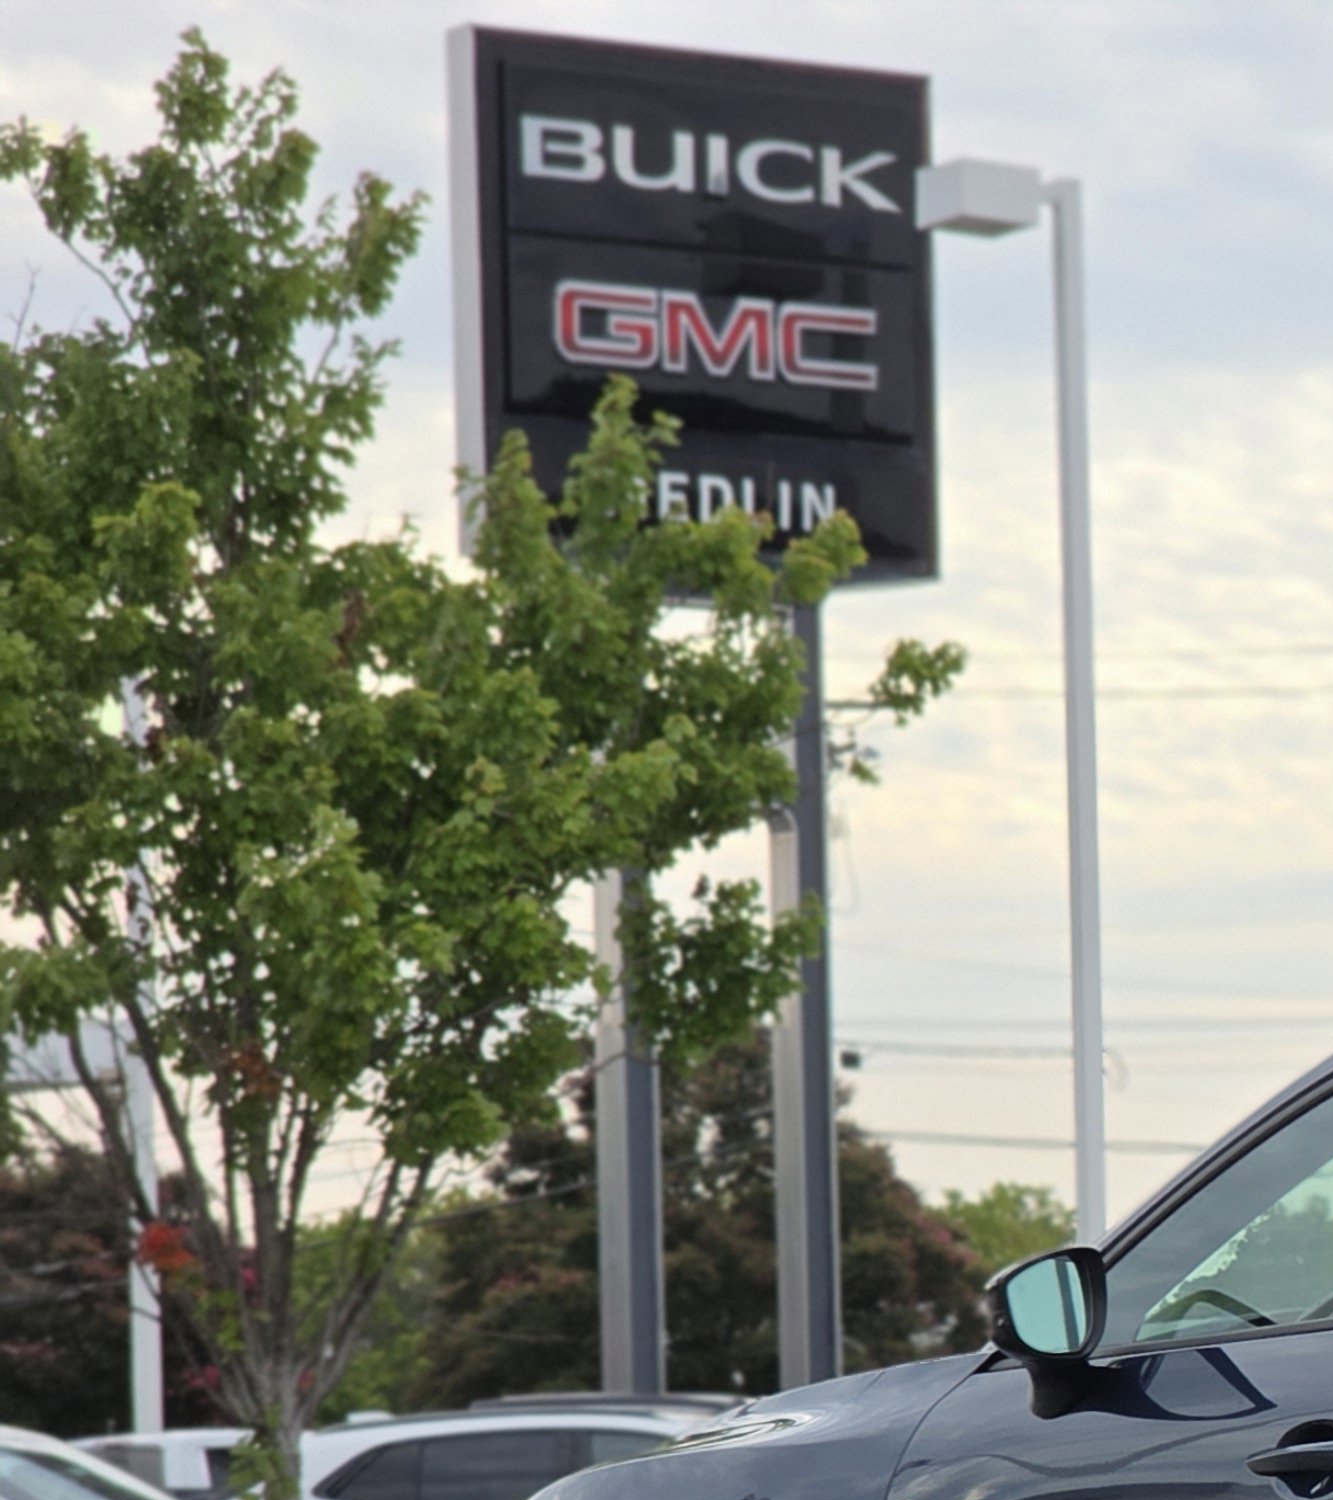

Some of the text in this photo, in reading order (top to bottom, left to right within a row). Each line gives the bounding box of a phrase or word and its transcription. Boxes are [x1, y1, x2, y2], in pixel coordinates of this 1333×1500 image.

[519, 114, 902, 213] BUICK
[554, 278, 877, 390] GMC
[606, 468, 836, 534] EDLIN
